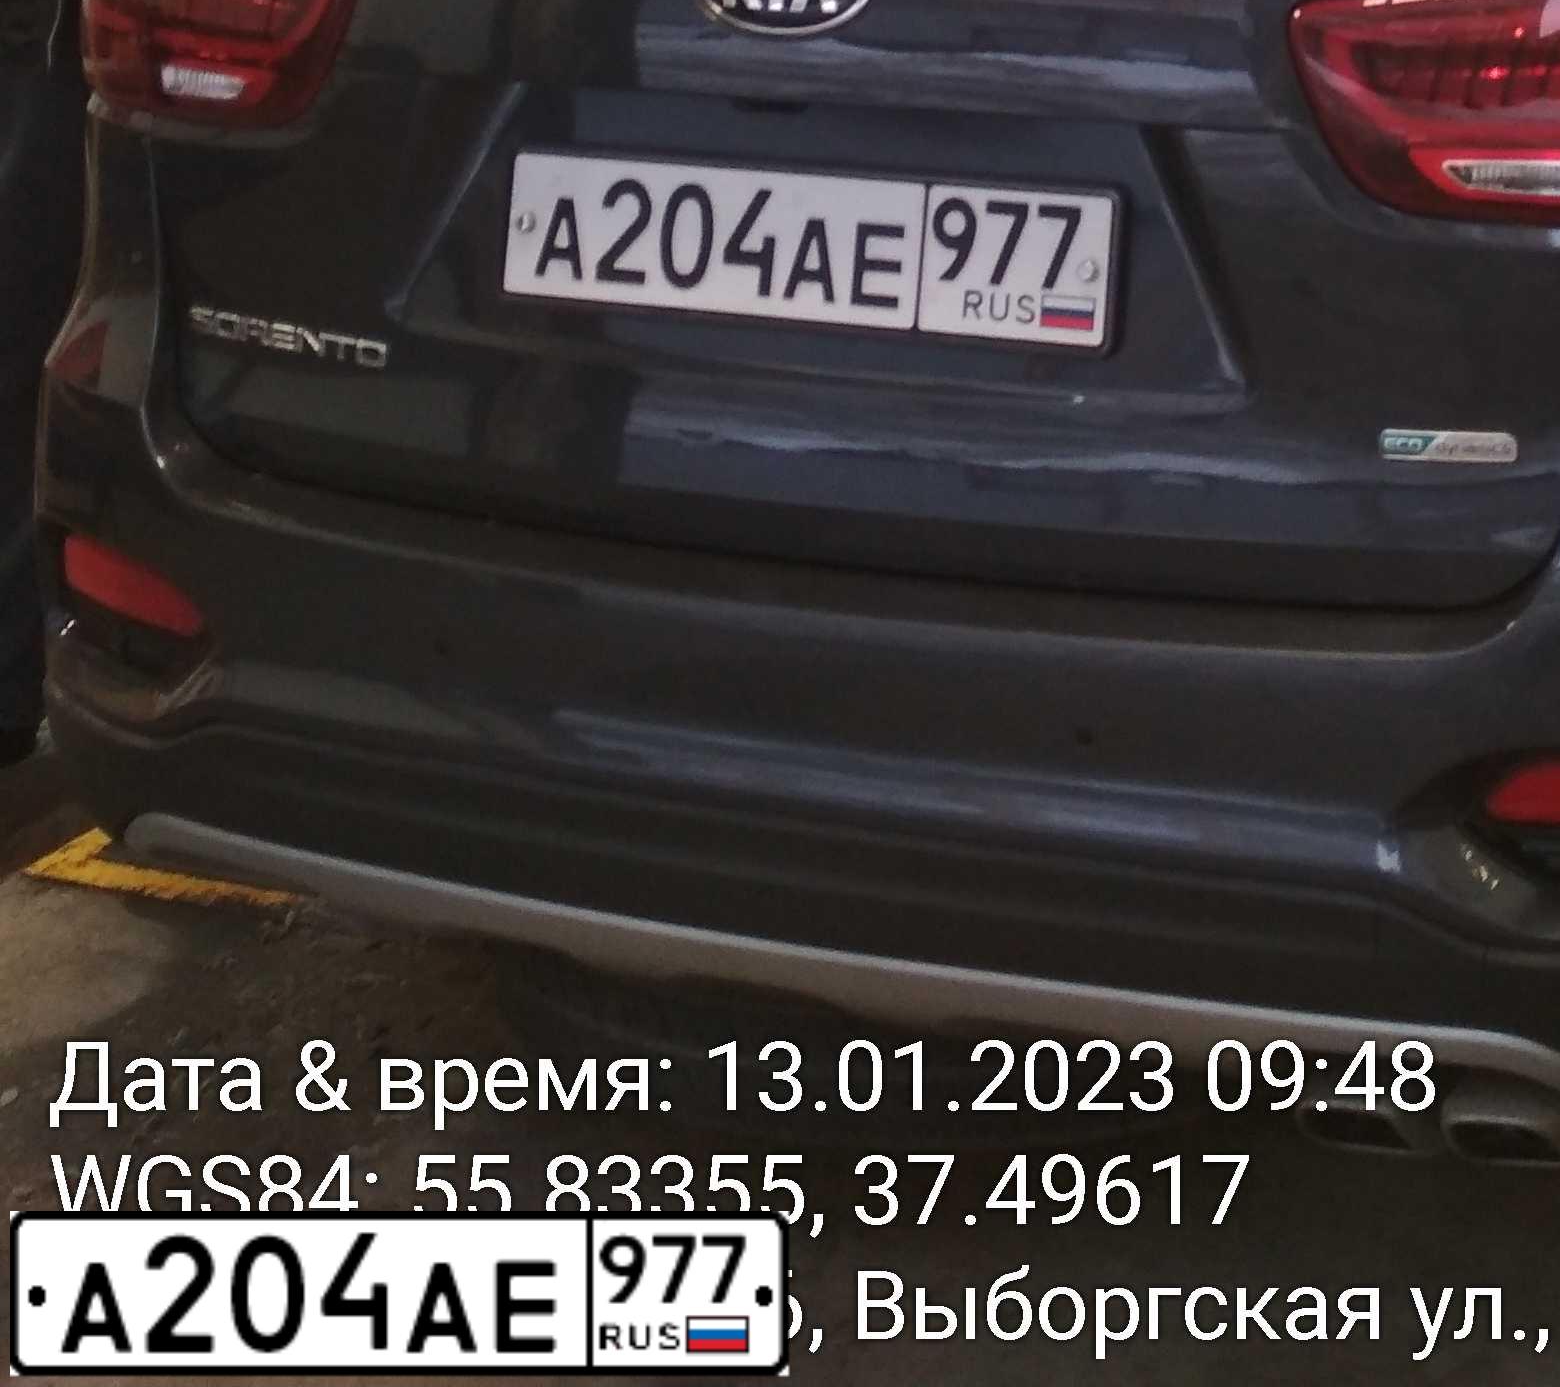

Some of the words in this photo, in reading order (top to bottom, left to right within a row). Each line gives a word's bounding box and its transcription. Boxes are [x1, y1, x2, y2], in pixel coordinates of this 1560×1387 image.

[932, 198, 1082, 288] 977
[190, 306, 387, 368] SORENTO
[962, 290, 1035, 323] RUS
